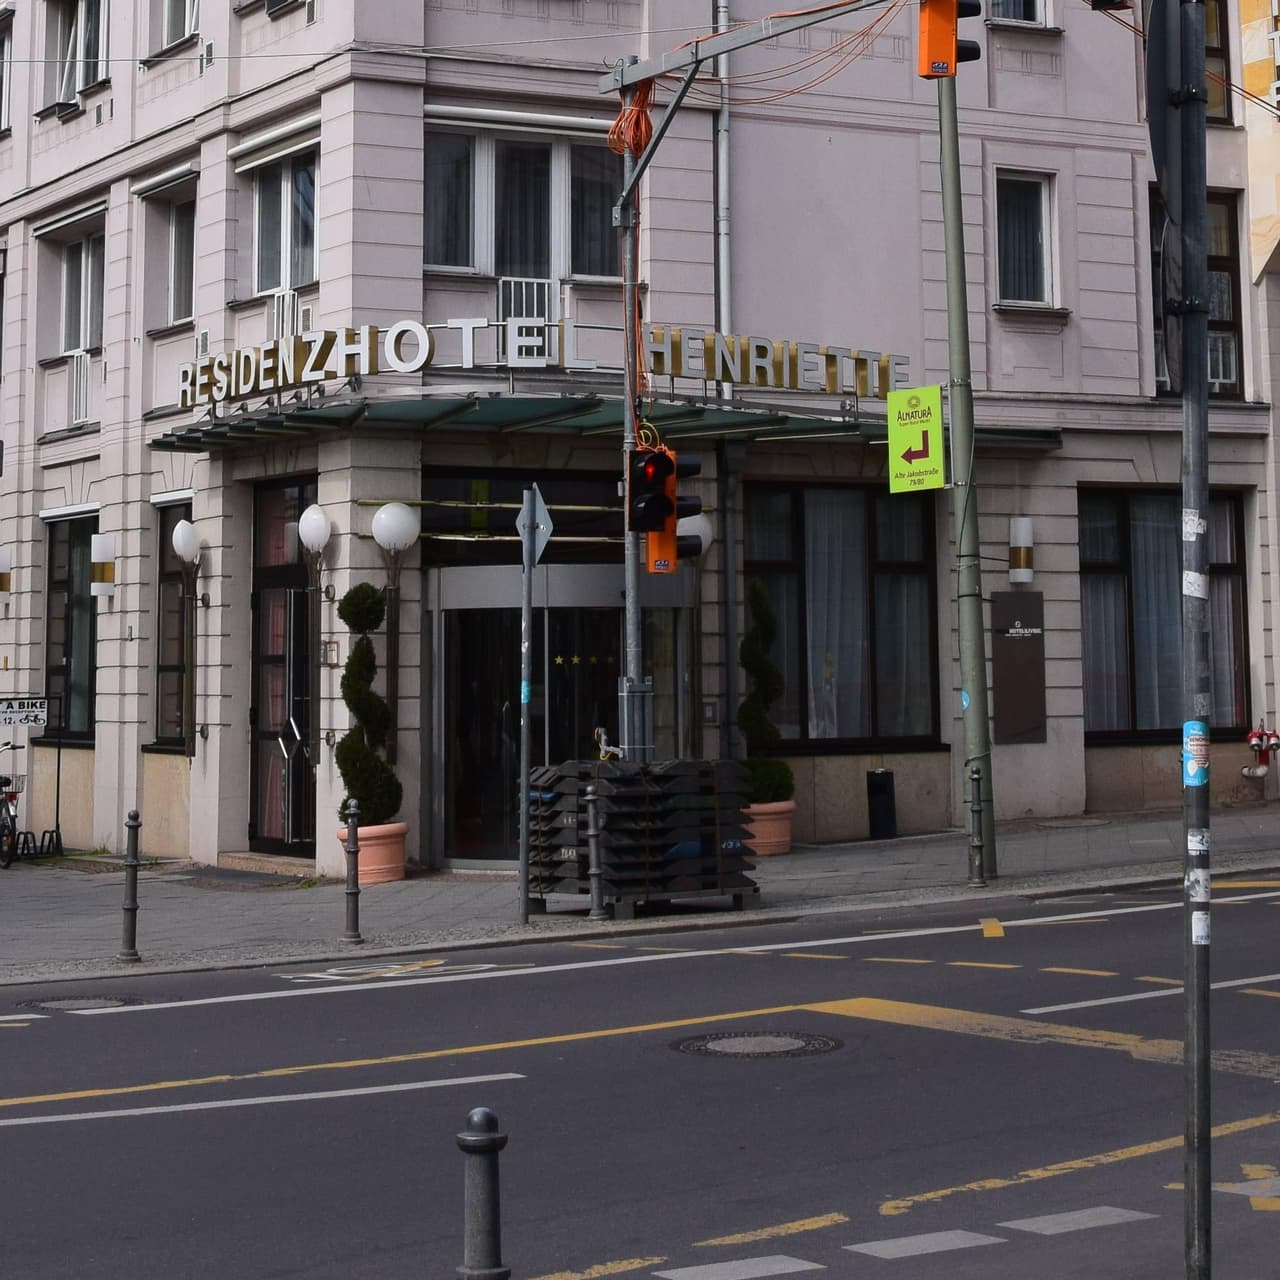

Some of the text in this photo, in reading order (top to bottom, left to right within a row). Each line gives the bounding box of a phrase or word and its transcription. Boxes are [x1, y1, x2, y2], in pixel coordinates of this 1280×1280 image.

[177, 316, 911, 408] RESIDENZHOTEL HENRIETTE
[6, 701, 15, 709] A
[18, 700, 46, 710] BIKE
